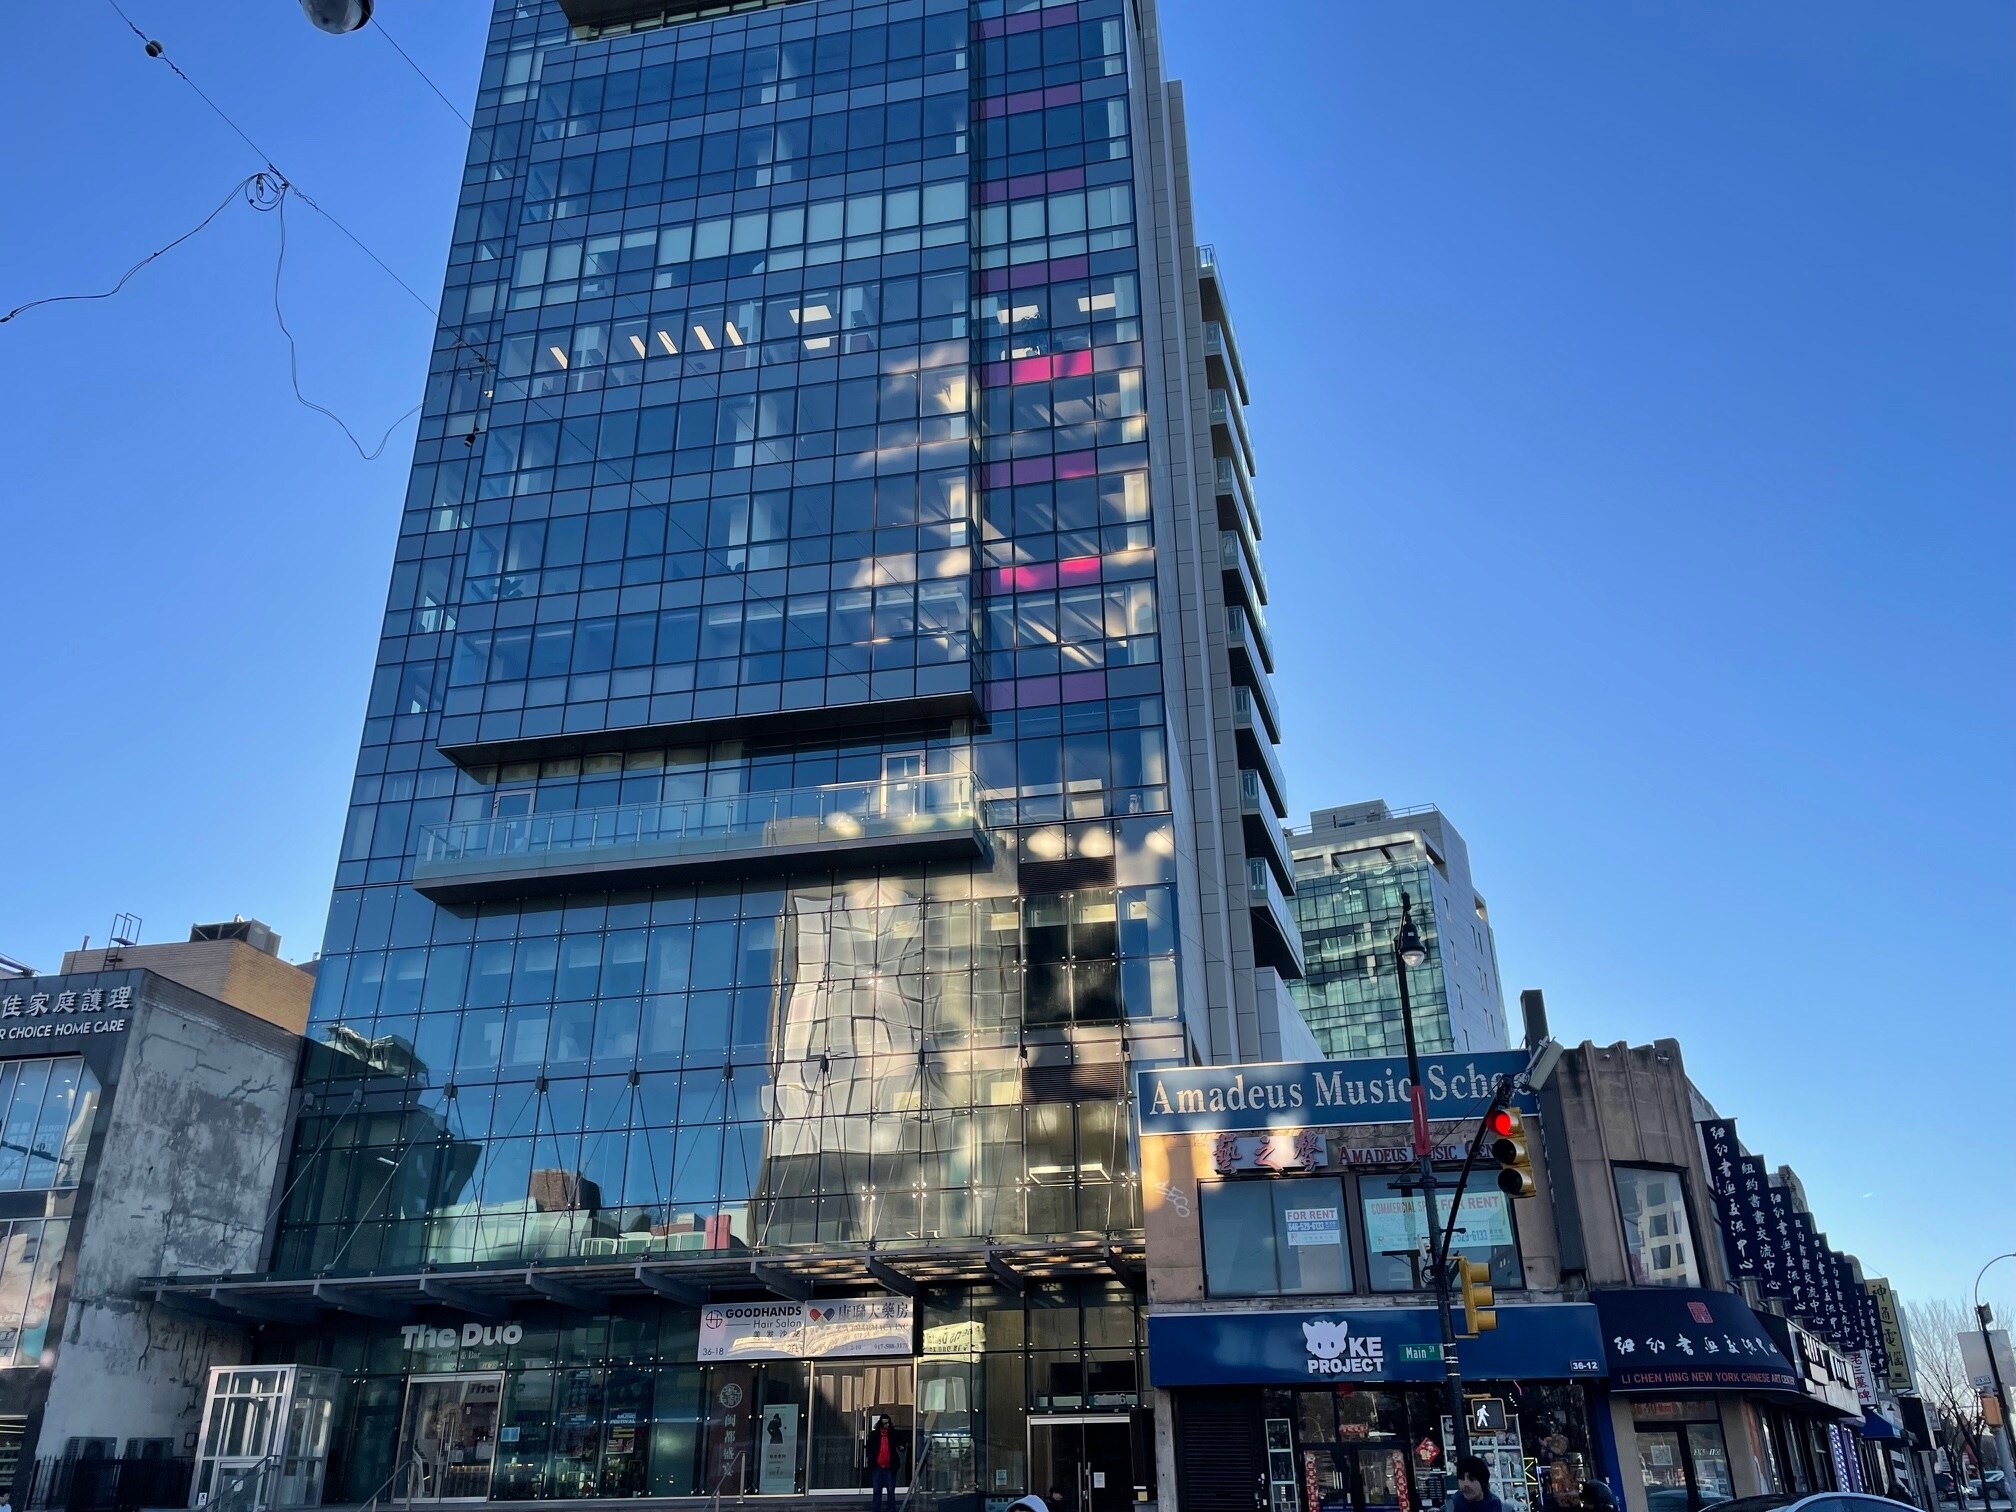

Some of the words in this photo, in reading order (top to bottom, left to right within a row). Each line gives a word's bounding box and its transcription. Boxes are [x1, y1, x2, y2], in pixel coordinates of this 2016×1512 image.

[2, 986, 131, 1018] 佳家庭護理
[9, 1025, 52, 1039] CHOICE
[55, 1022, 91, 1036] HOME
[94, 1019, 125, 1033] CARE
[1150, 1074, 1303, 1115] Amadeus
[1312, 1068, 1411, 1107] Music
[1428, 1063, 1533, 1101] Schoo
[1338, 1145, 1408, 1164] AMADEUS
[1411, 1143, 1457, 1161] SIC
[1371, 1201, 1416, 1215] COMMERCIAL
[1468, 1196, 1499, 1209] RENT
[1287, 1211, 1306, 1220] FOR
[1310, 1210, 1335, 1219] RENT
[1741, 1162, 1782, 1290] 紐約書畫交流中心
[725, 1306, 802, 1319] GOODHANDS
[753, 1320, 774, 1329] Hair
[776, 1319, 802, 1328] Salon
[401, 1324, 457, 1350] The
[461, 1323, 523, 1347] Duo
[703, 1348, 724, 1356] 36-18
[1405, 1346, 1427, 1359] Main
[1307, 1358, 1384, 1374] PROJECT
[1572, 1361, 1598, 1370] 36-12
[1621, 1374, 1630, 1384] LI
[1633, 1373, 1662, 1384] CHEN
[1664, 1372, 1689, 1382] HING
[1691, 1371, 1713, 1382] NEW
[1715, 1372, 1740, 1382] YORK
[1741, 1373, 1770, 1383] CHINESE
